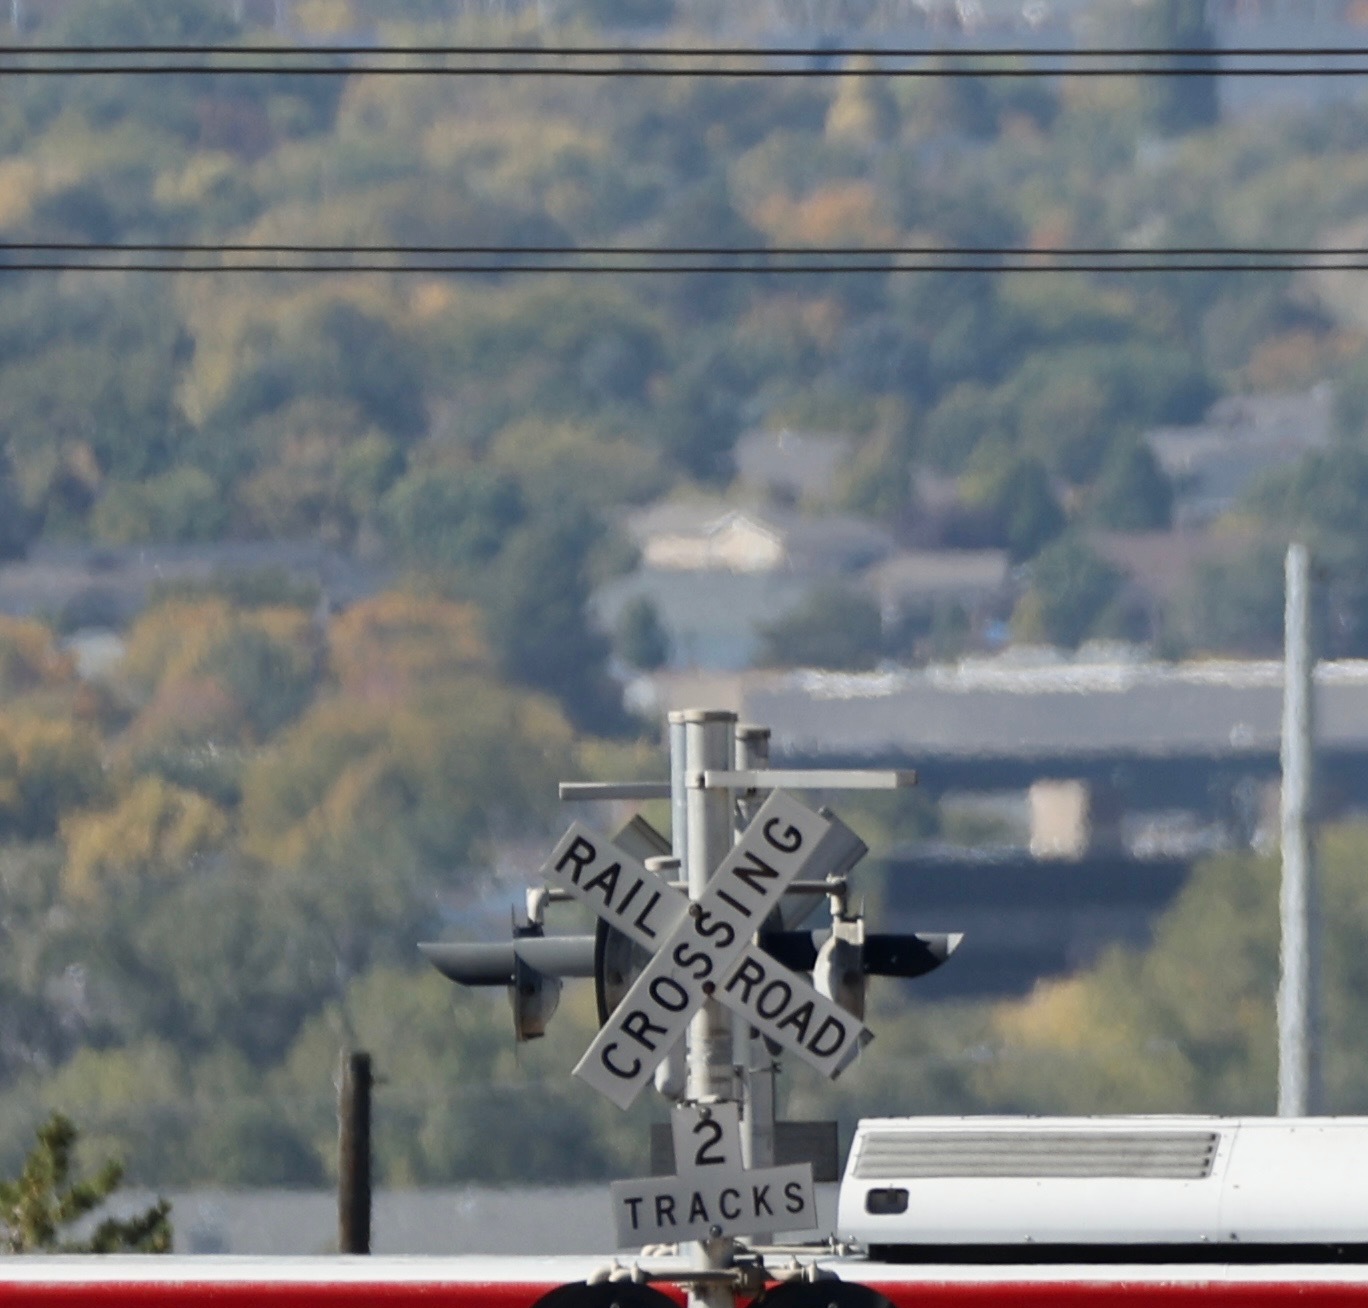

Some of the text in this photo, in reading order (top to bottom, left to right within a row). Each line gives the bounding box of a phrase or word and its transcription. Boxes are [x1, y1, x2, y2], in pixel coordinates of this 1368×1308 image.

[554, 834, 847, 1058] RAIL ROAD
[600, 817, 803, 1080] CROSSING
[624, 1182, 804, 1230] TRACKS
[693, 1119, 725, 1166] 2
